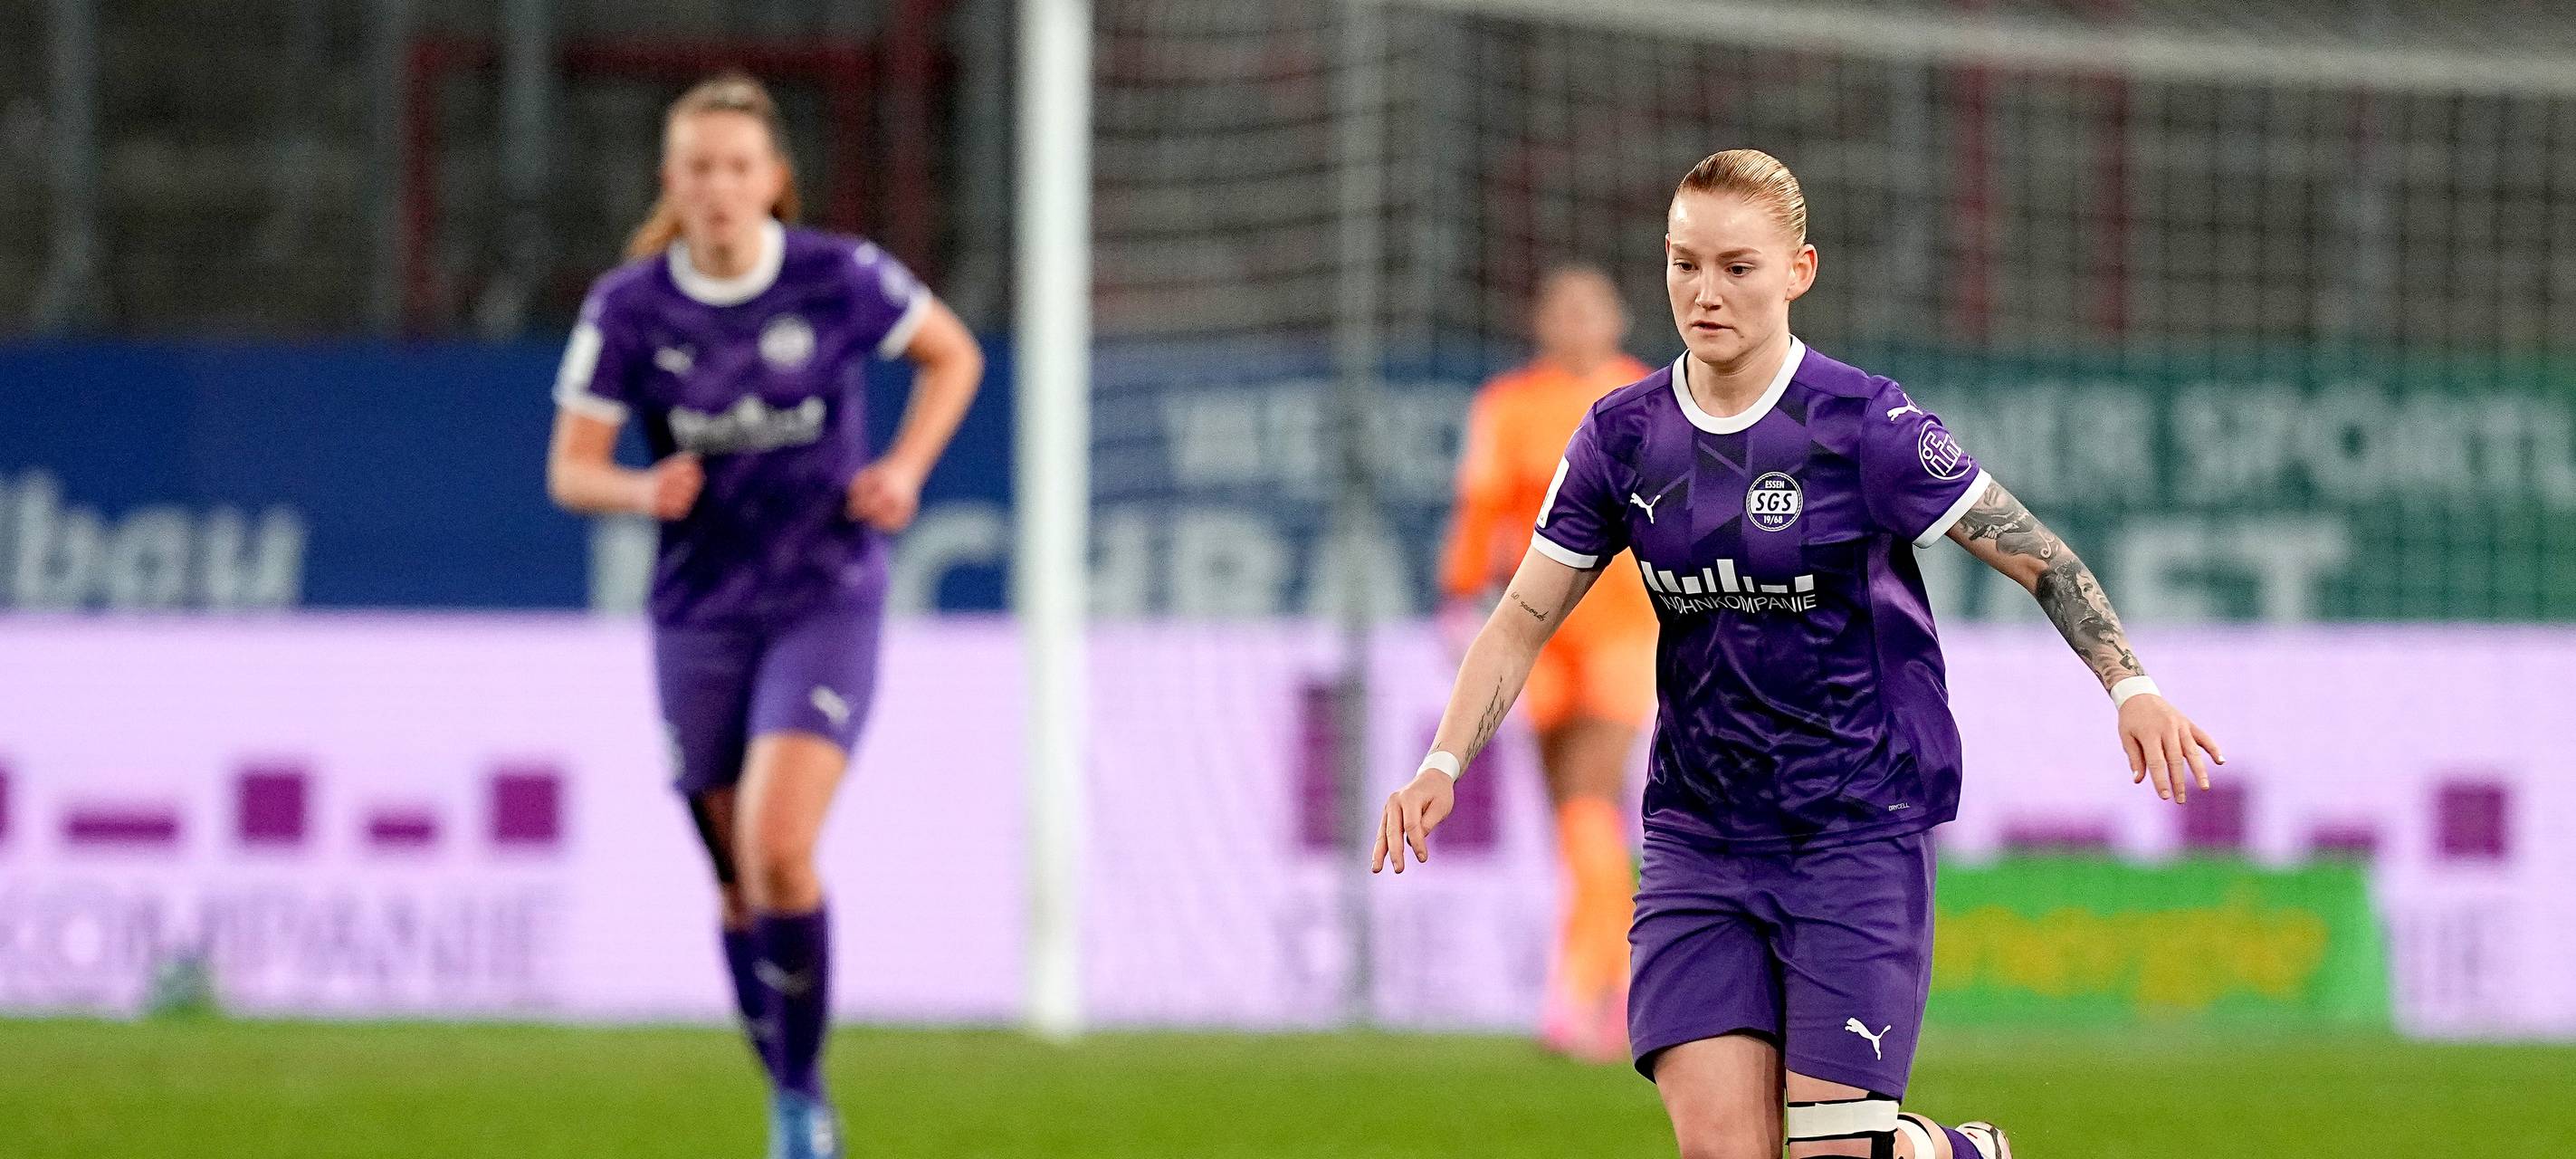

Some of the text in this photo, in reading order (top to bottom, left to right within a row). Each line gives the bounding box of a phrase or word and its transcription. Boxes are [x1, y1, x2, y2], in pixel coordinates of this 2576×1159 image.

[1765, 480, 1785, 489] ESSEN
[1755, 493, 1792, 512] SGS
[1763, 514, 1783, 525] 19/68
